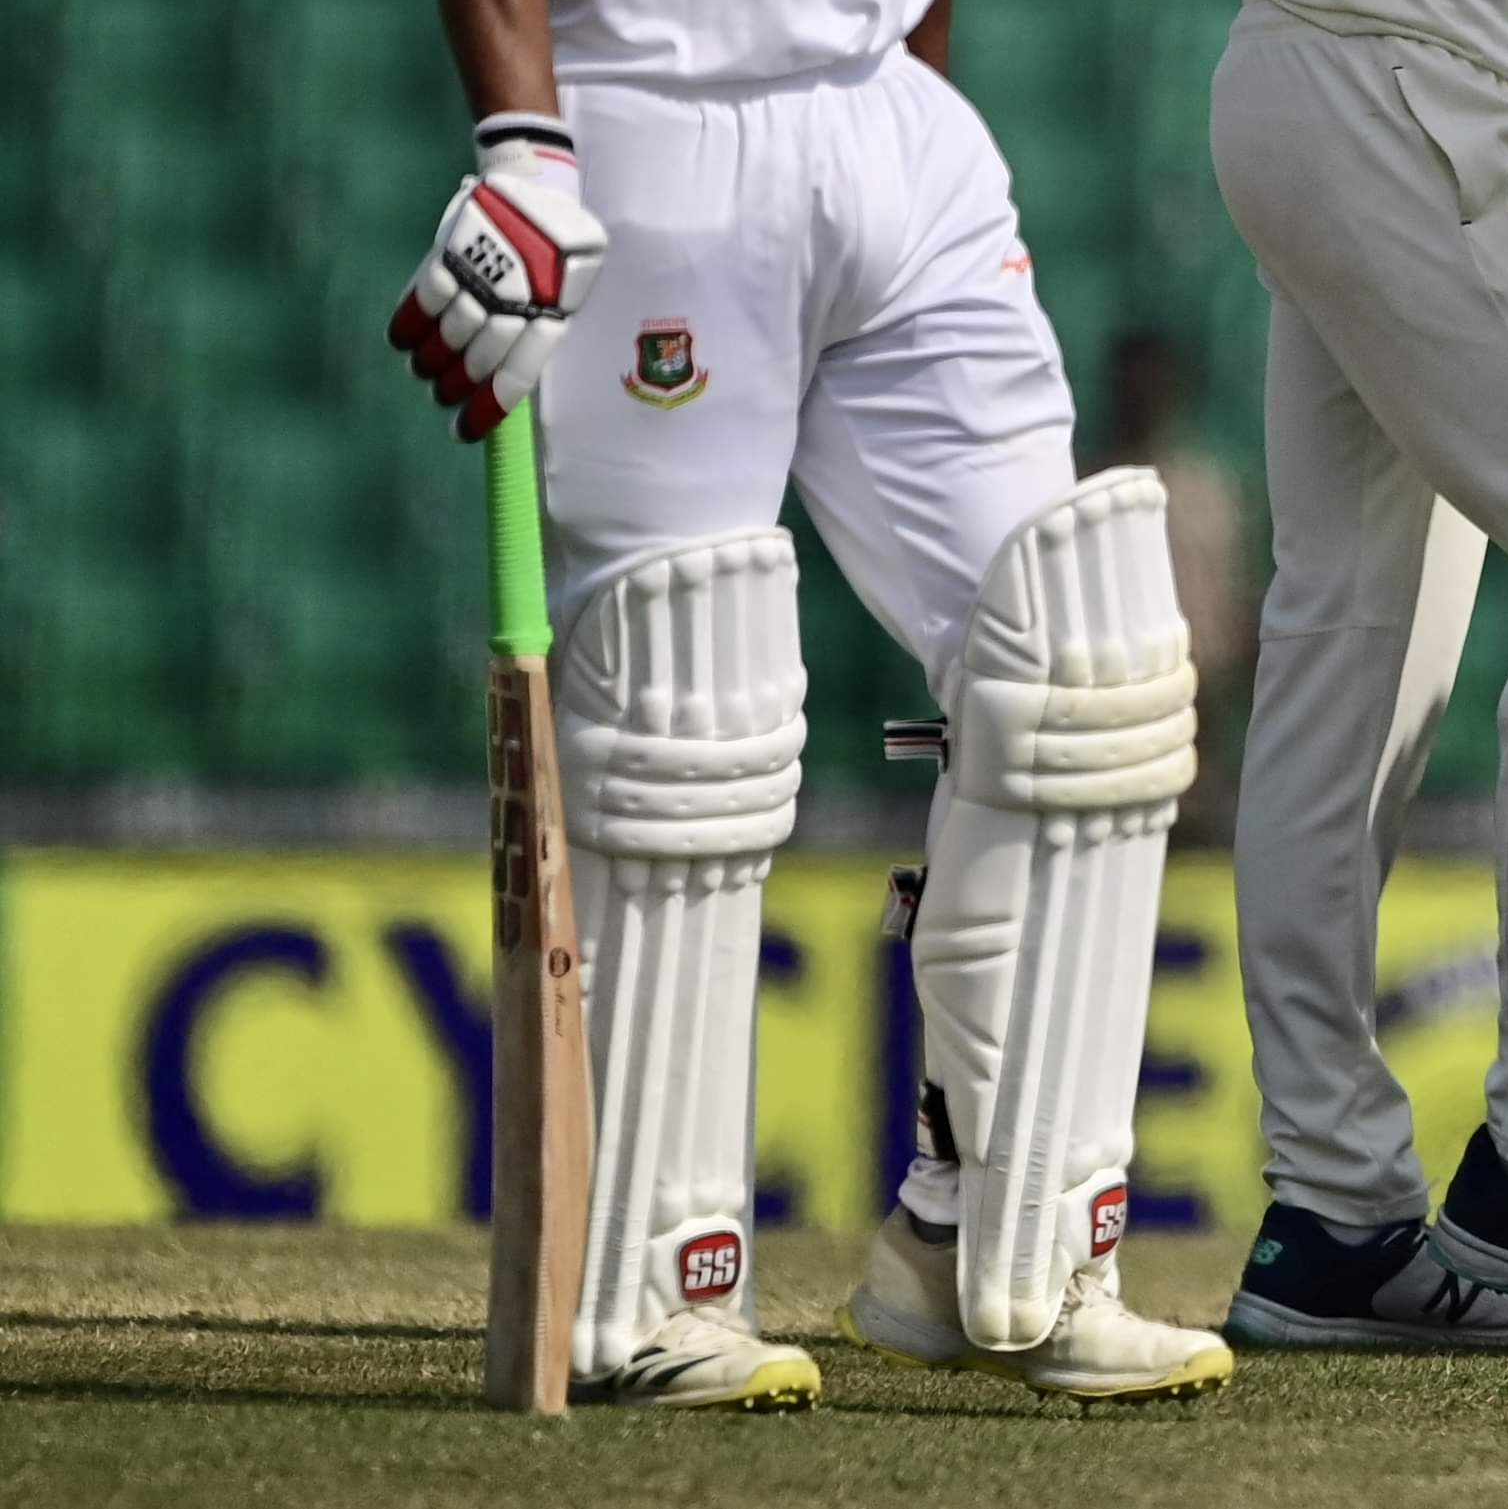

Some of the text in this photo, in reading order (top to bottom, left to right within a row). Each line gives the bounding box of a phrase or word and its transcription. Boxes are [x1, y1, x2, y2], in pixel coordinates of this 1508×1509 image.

[132, 920, 1218, 1224] CYLE
[1094, 1201, 1127, 1244] SS
[684, 1244, 736, 1291] SS
